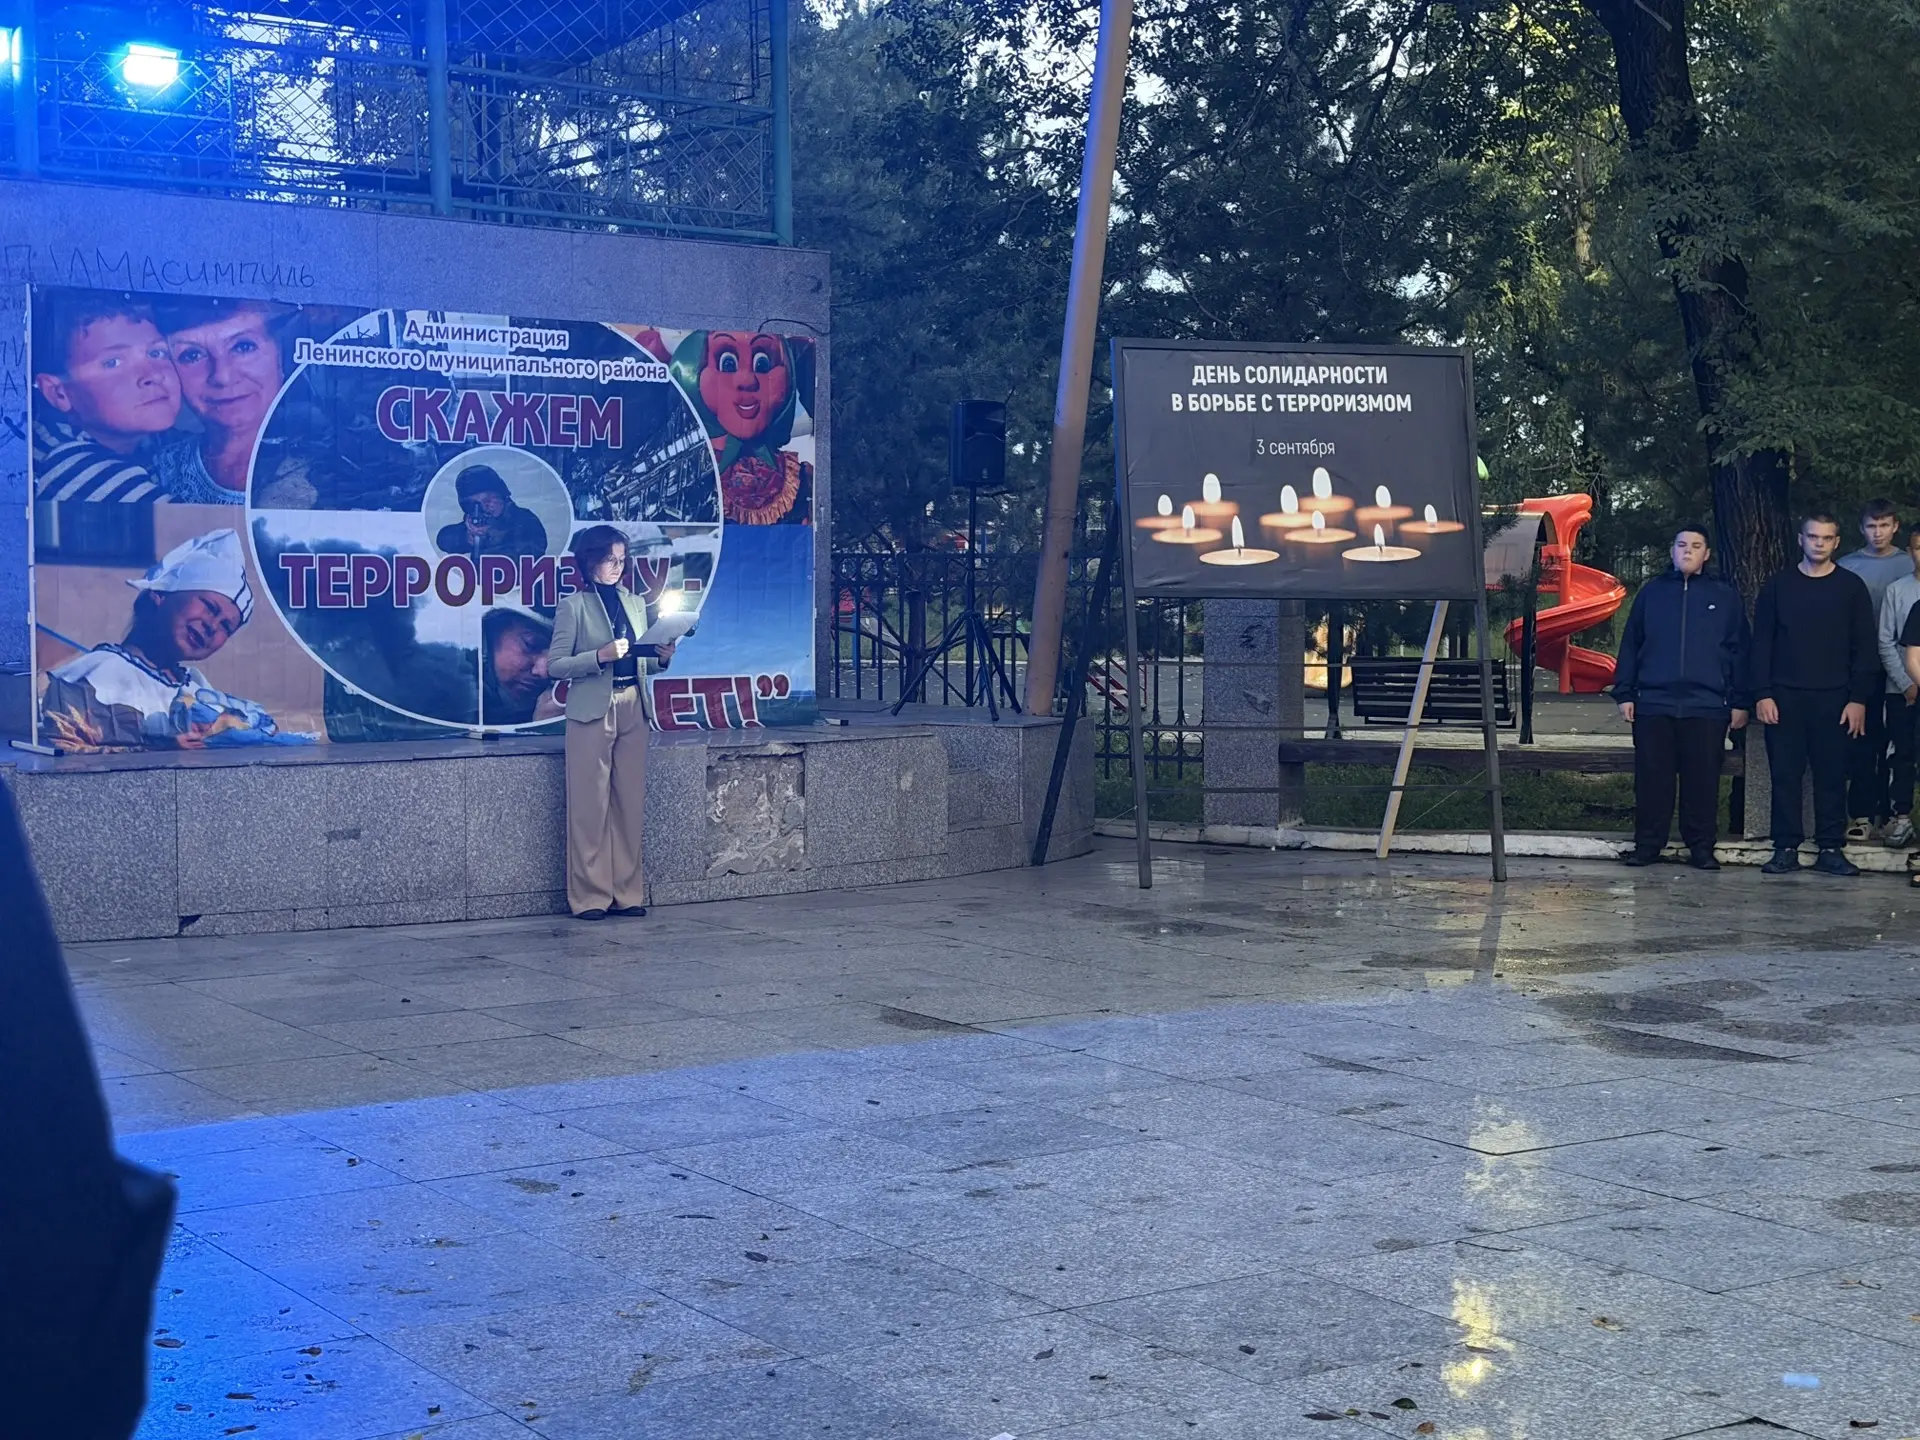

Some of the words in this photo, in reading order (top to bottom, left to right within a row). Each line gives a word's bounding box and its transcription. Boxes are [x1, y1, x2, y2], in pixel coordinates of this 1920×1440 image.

[407, 319, 568, 349] Администрация
[296, 341, 423, 369] Ленинского
[428, 353, 596, 380] муниципального
[599, 360, 669, 383] района
[1192, 365, 1241, 387] ДЕНЬ
[1245, 365, 1388, 387] СОЛИДАРНОСТИ
[377, 385, 623, 448] СКАЖЕМ
[1171, 393, 1184, 412] В
[1188, 393, 1257, 412] БОРЬБЕ
[1261, 393, 1273, 412] С
[1278, 393, 1413, 413] ТЕРРОРИЗМОМ
[1256, 438, 1265, 455] 3
[1269, 438, 1336, 459] сентября
[279, 553, 671, 608] ТЕРРОРИЗУ
